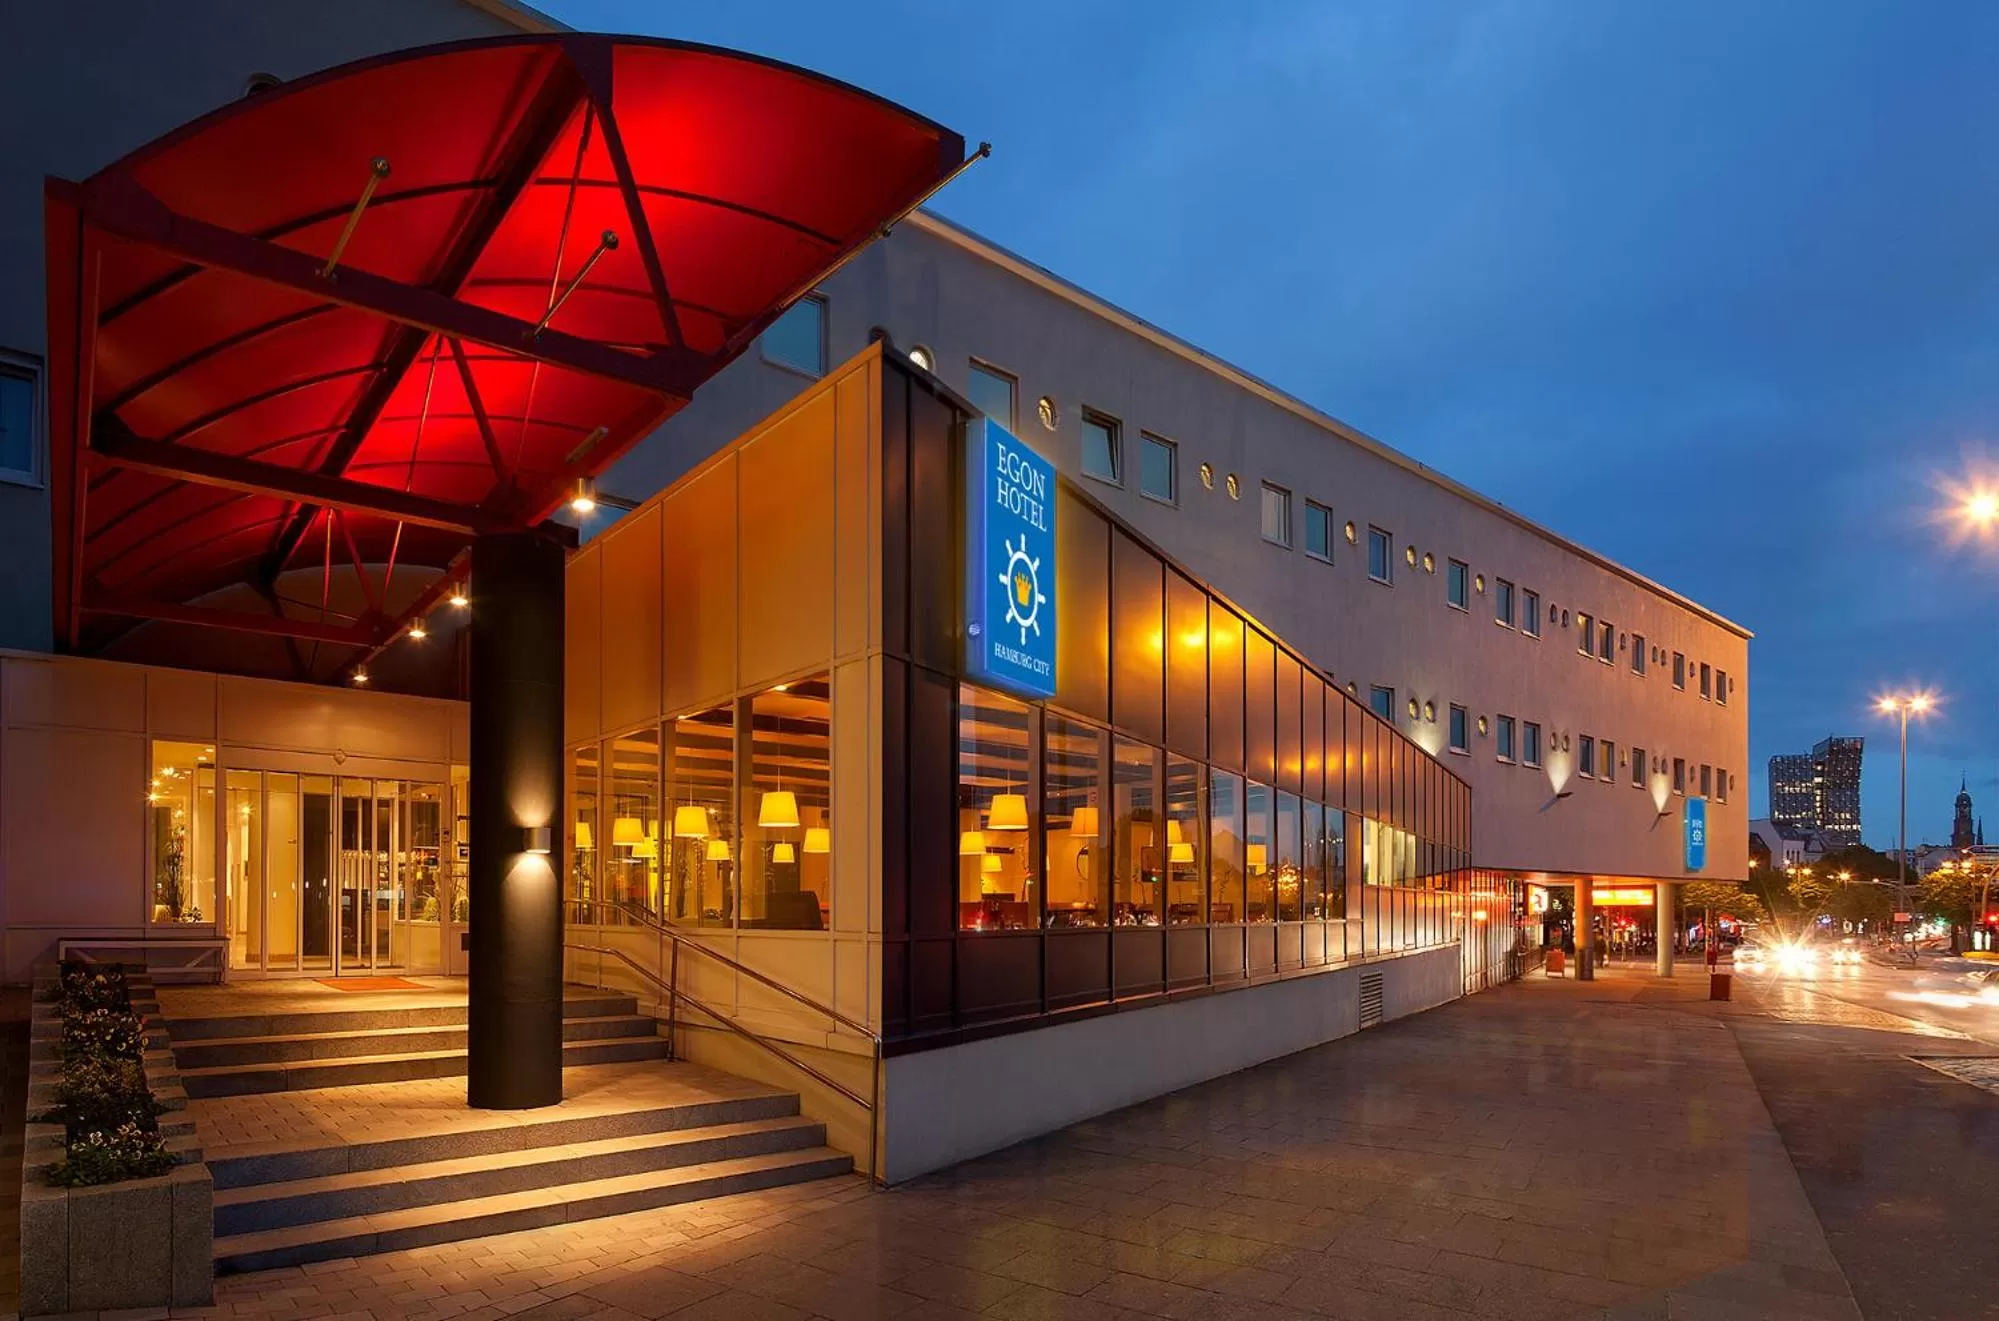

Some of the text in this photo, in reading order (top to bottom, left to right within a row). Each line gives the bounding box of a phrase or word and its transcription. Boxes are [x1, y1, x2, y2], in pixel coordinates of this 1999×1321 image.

[997, 441, 1045, 501] EGON
[997, 476, 1047, 532] HOTEL
[994, 642, 1032, 669] HAMBURG
